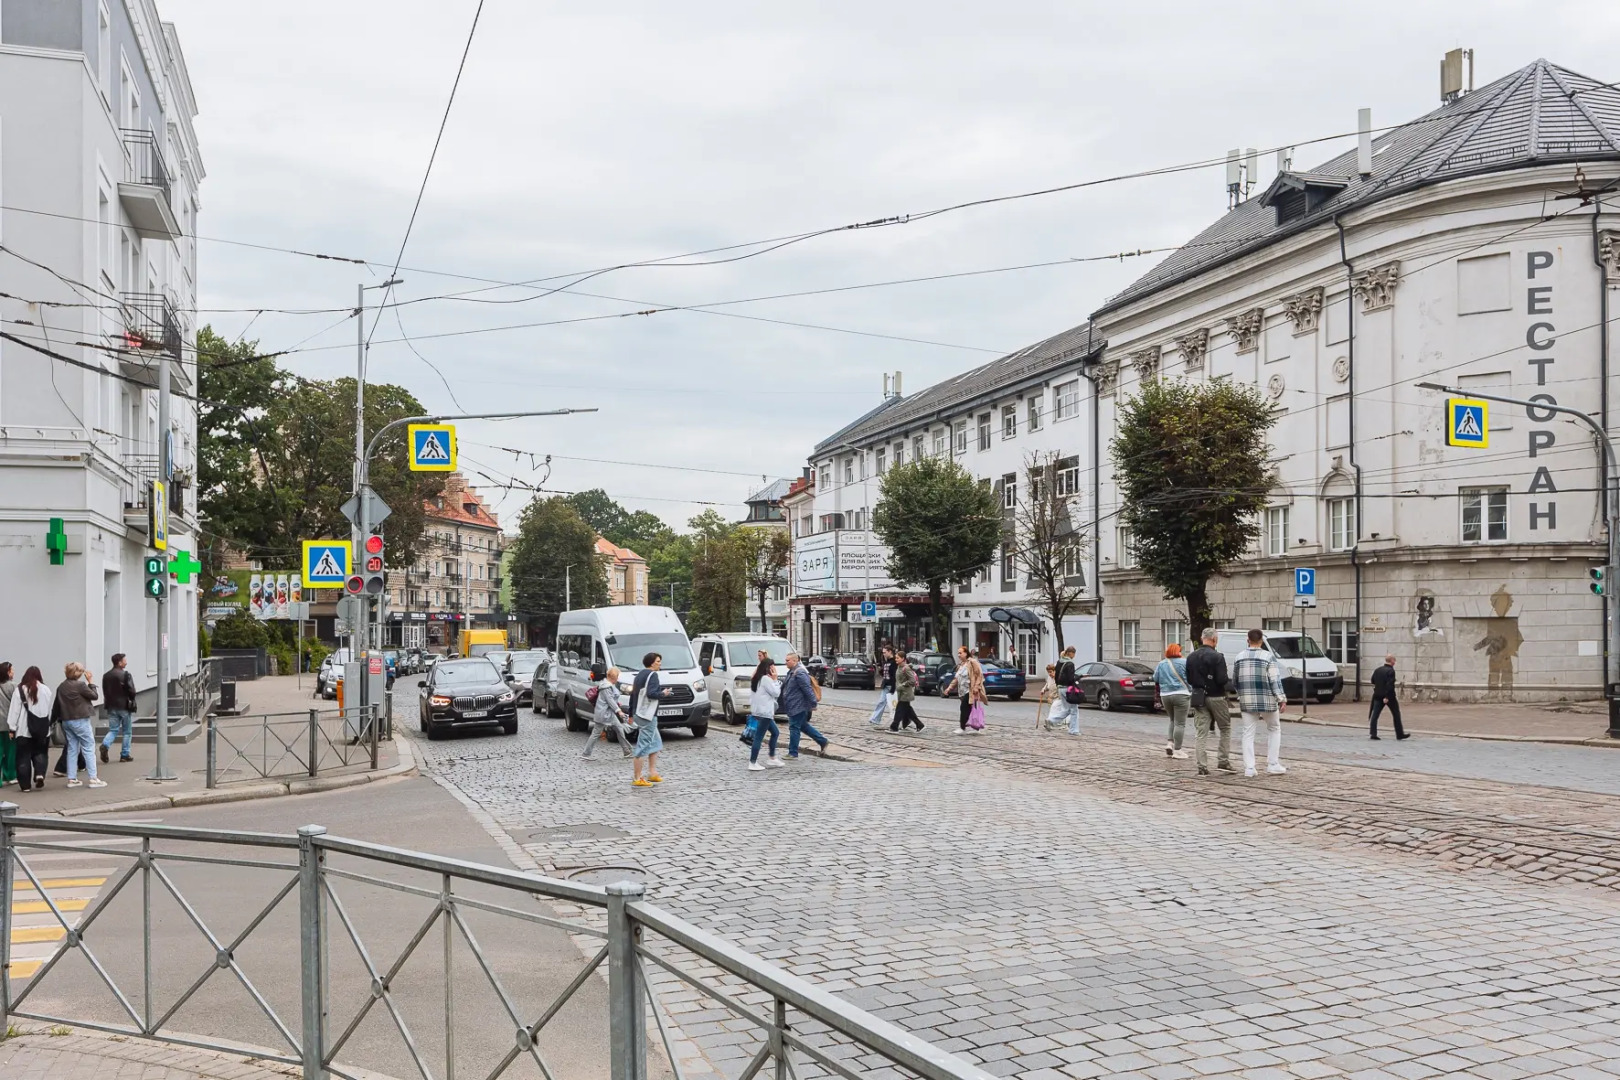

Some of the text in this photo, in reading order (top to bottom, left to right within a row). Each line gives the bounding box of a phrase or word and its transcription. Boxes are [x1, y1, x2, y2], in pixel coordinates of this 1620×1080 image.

[1526, 251, 1558, 530] РЕСТОРАН
[368, 558, 381, 571] 20
[802, 556, 829, 572] ЗАРЯ
[1300, 571, 1310, 592] P
[865, 603, 873, 616] P
